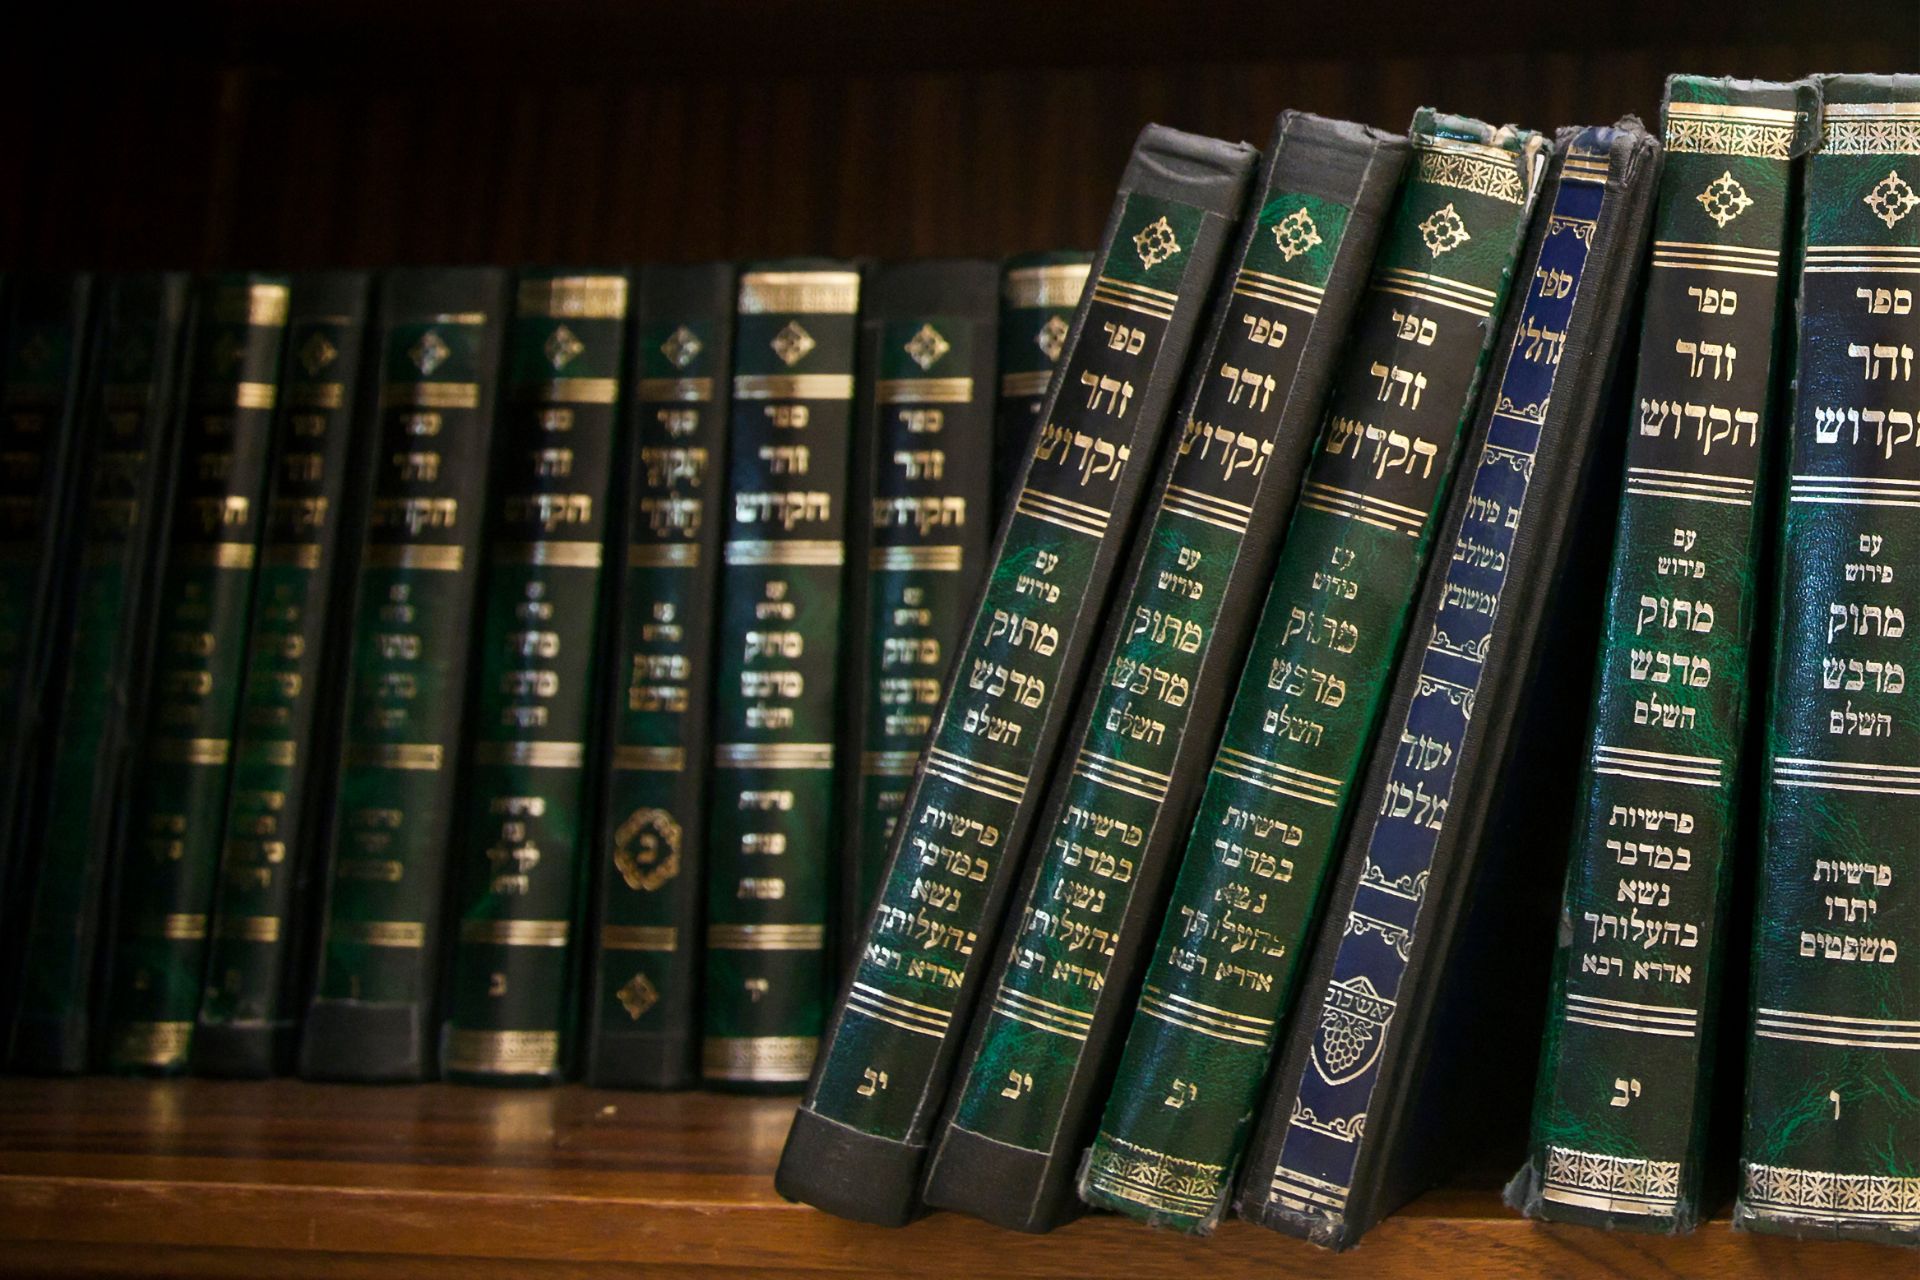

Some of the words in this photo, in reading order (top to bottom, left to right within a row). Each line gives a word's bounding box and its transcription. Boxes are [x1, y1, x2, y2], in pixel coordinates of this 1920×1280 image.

[1536, 266, 1573, 299] ספר
[1688, 286, 1737, 315] ספר
[1856, 286, 1912, 315] ספר
[1104, 319, 1146, 355] ספר
[1242, 312, 1288, 349] ספר
[1391, 308, 1437, 347] ספר
[1676, 338, 1737, 381] זהר
[1848, 342, 1914, 382] זהר
[1081, 369, 1134, 418] זהר
[1220, 362, 1276, 413] זהר
[1370, 361, 1427, 411] זהר
[1640, 398, 1759, 456] הקדוש
[1815, 406, 1920, 460] קדוש
[1325, 415, 1437, 480] הקדוש
[1177, 546, 1201, 571] עם
[1673, 527, 1697, 552] עם
[1859, 533, 1883, 557] עם
[1035, 550, 1059, 575] עם
[1658, 556, 1706, 579] פירוש
[1845, 563, 1893, 584] פירוש
[1015, 574, 1060, 604] פירוש
[1157, 571, 1204, 600] פירוש
[984, 609, 1059, 657] מתוק
[1125, 605, 1202, 654] מתוק
[1636, 594, 1714, 636] מתוק
[1827, 602, 1905, 644] מתוק
[969, 658, 1045, 709] מדבש
[1111, 656, 1189, 708] מדבש
[1268, 657, 1345, 707] מדבש
[1630, 648, 1711, 688] מדבש
[1822, 657, 1905, 694] מדבש
[963, 703, 1023, 747] השלם
[1105, 702, 1166, 746] השלם
[1263, 703, 1324, 746] השלם
[1634, 692, 1696, 730] השלם
[1829, 700, 1892, 738] השלם
[1401, 728, 1452, 771] יסוד
[920, 805, 1000, 848] פרשיות
[1062, 804, 1143, 847] פרשיות
[1221, 804, 1303, 847] פרשיות
[1609, 805, 1694, 834] פרשיות
[912, 837, 988, 882] במדבר
[1055, 837, 1133, 883] במדבר
[1214, 838, 1294, 882] במדבר
[1606, 839, 1691, 871] במדבר
[1813, 859, 1892, 887] פרשיות
[910, 877, 961, 912] נשא
[1053, 878, 1106, 912] נשא
[1617, 878, 1671, 907] נשא
[1825, 896, 1877, 923] יתרו
[1584, 908, 1698, 950] בהעלותך
[1800, 931, 1898, 964] משפטים
[908, 959, 965, 988] אדרא
[1582, 953, 1623, 977] רבא
[1633, 960, 1692, 984] אדרא
[857, 1067, 889, 1098] יב
[1001, 1069, 1033, 1100] יב
[1610, 1077, 1642, 1108] יב
